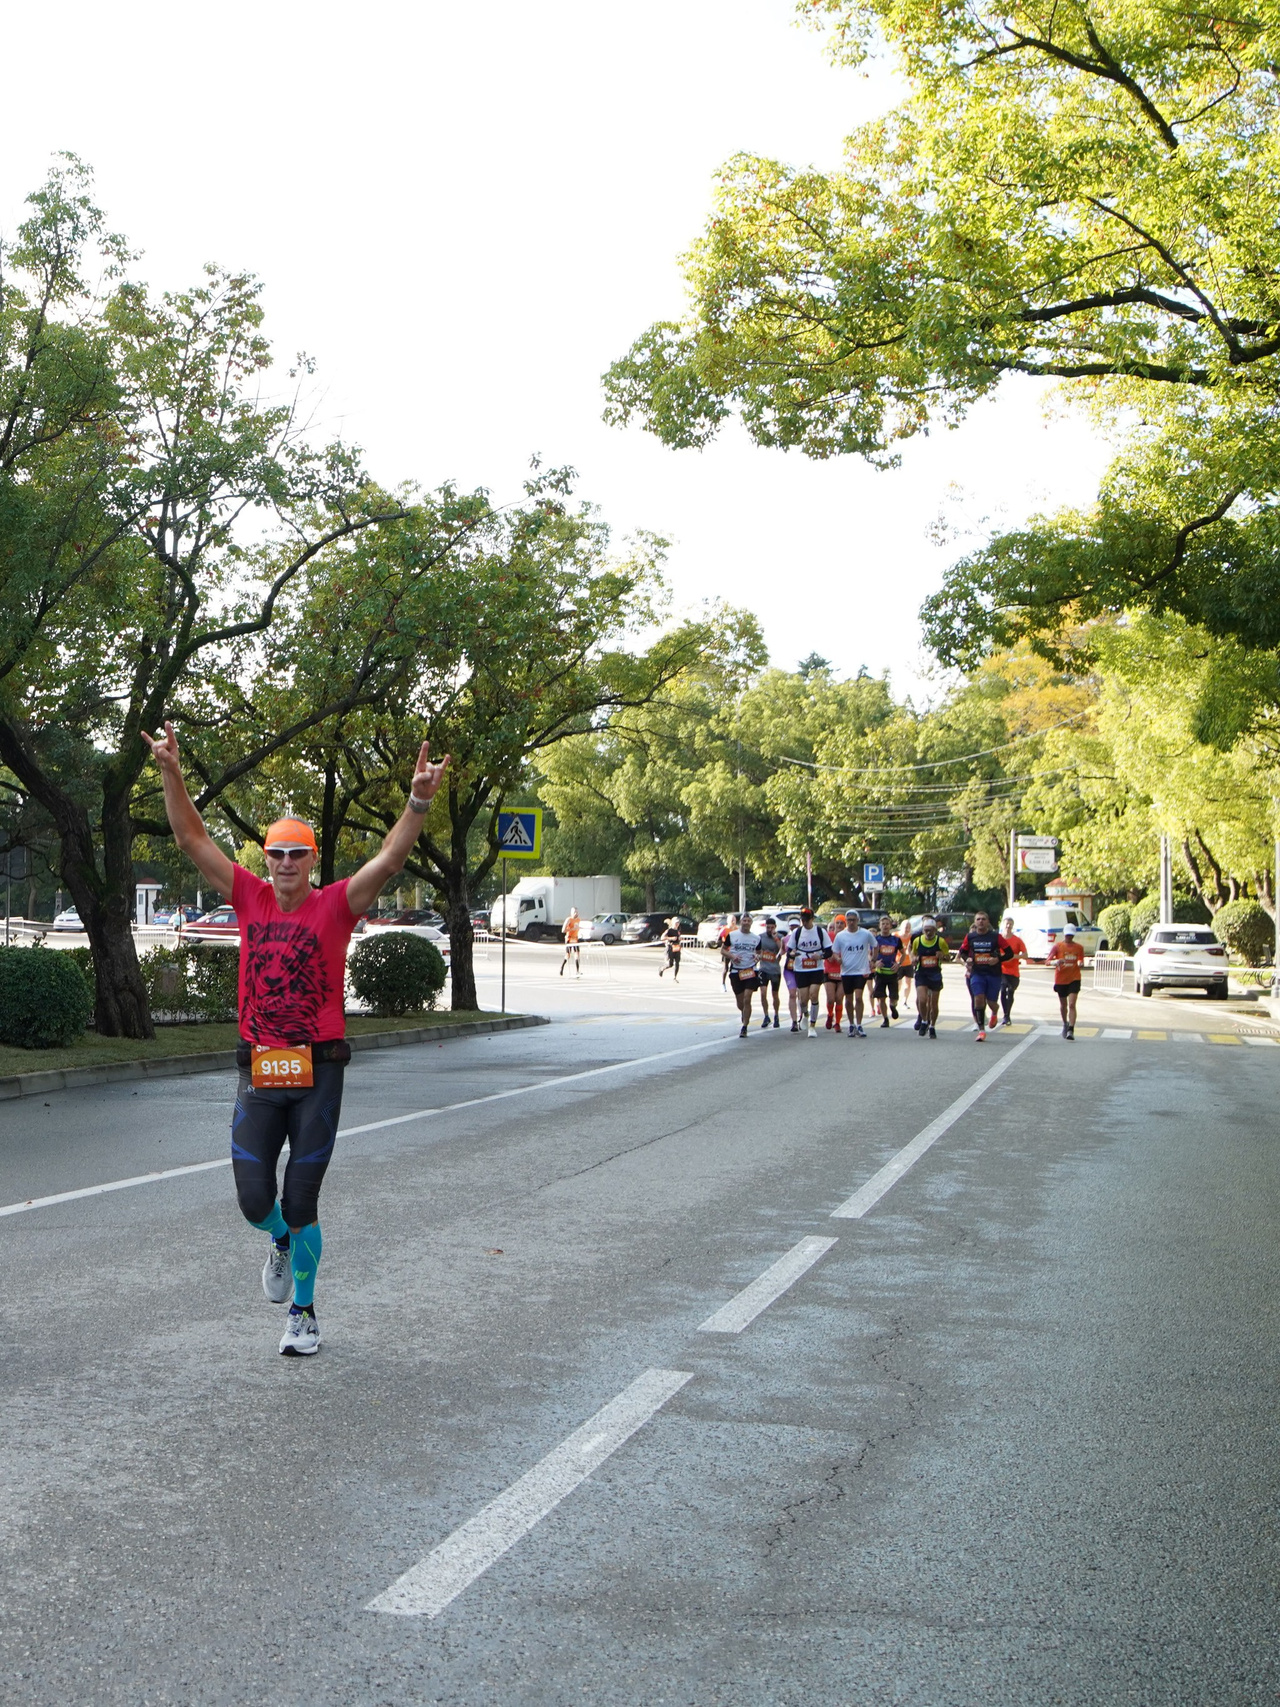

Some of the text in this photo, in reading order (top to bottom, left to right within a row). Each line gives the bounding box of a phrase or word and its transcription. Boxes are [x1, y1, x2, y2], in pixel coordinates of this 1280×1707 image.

[869, 866, 879, 881] P
[847, 944, 864, 952] 4:14
[261, 1060, 302, 1075] 9135
